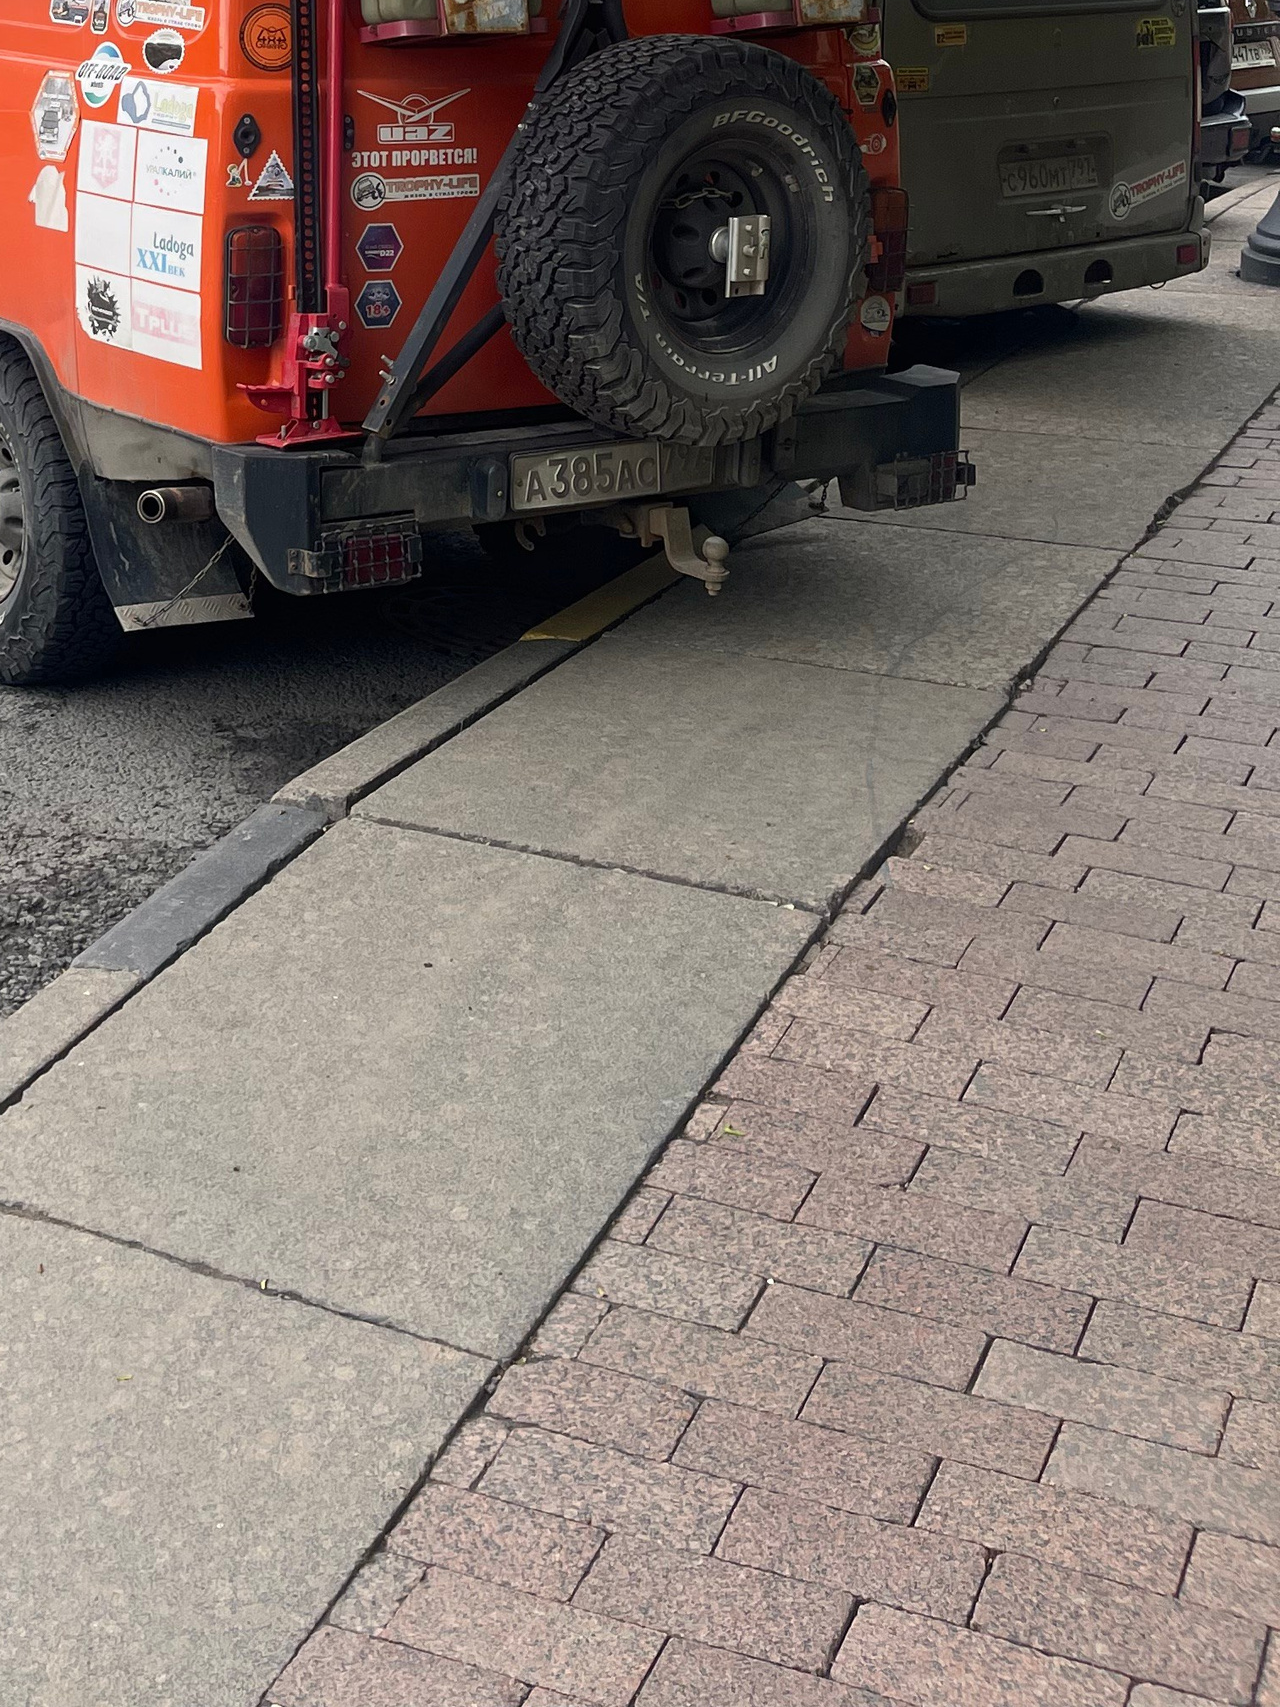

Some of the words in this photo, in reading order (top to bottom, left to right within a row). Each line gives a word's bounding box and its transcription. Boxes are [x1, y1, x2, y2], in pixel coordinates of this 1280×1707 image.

[1235, 25, 1278, 37] USTER
[78, 62, 129, 82] OFF-ROAD
[351, 150, 390, 169] ЭТОТ
[391, 147, 478, 168] ПРОРВЕТСЯ!
[711, 110, 835, 202] BFGoodrich
[385, 176, 479, 194] TROPHY-LIFE
[1130, 161, 1186, 197] TROPHY-LIFE
[153, 230, 195, 262] Ladoga
[136, 247, 168, 274] XXI
[365, 303, 391, 319] 18+
